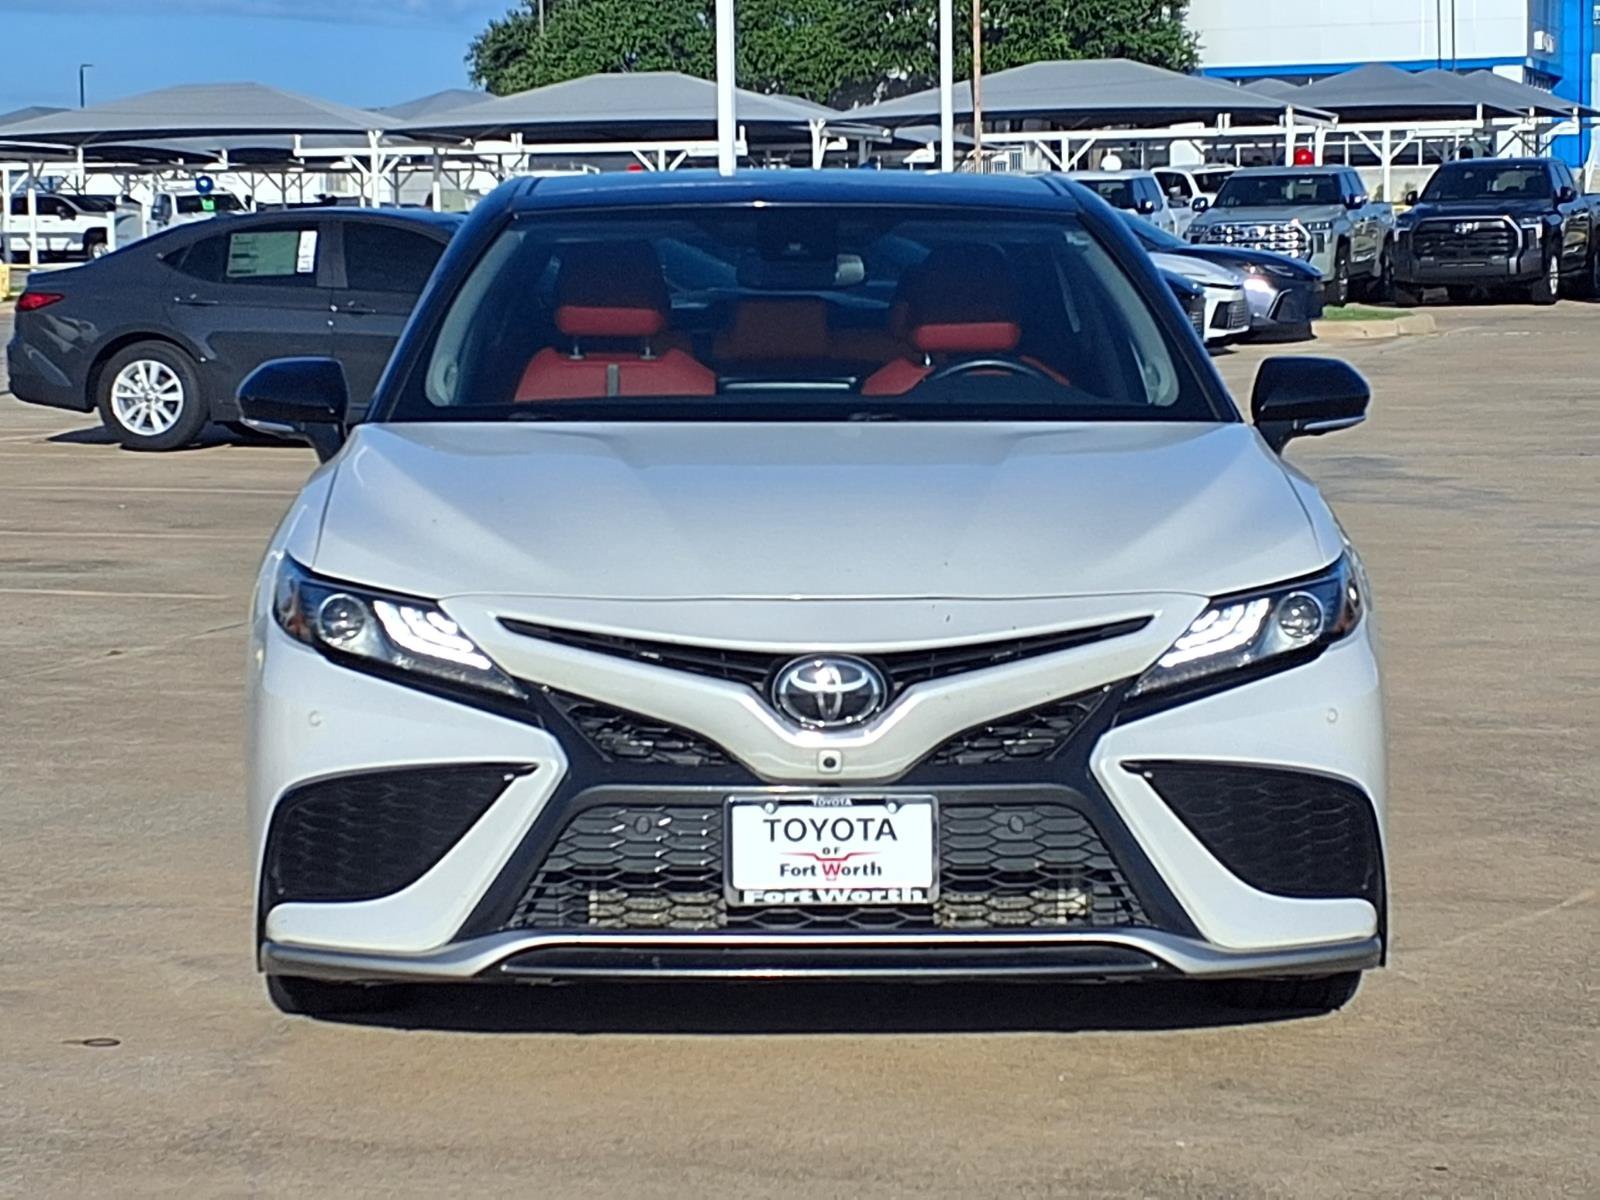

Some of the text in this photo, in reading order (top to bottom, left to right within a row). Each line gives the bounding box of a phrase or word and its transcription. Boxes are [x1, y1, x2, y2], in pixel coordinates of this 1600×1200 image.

[812, 797, 852, 807] TOYOTA
[763, 817, 898, 842] TOYOTA
[822, 847, 841, 855] OF
[779, 861, 882, 877] Fort Worth
[743, 888, 924, 904] Fort Worth
